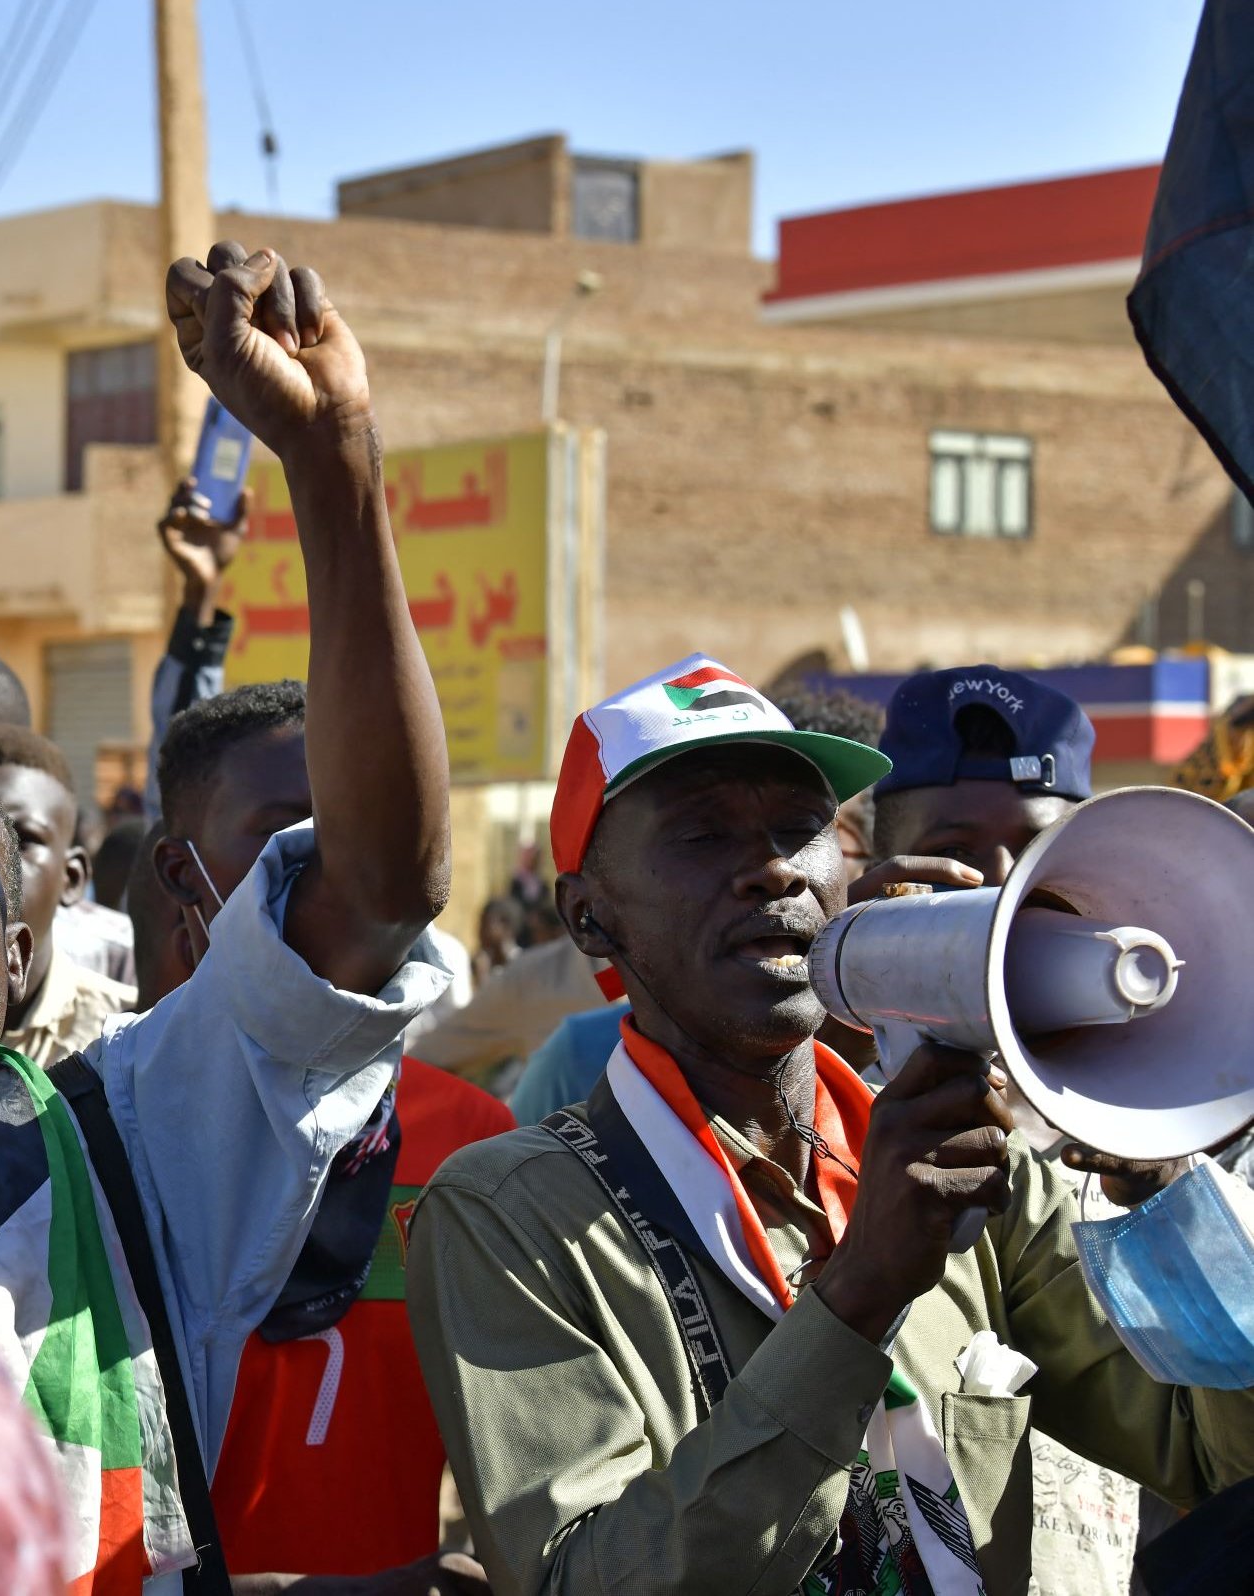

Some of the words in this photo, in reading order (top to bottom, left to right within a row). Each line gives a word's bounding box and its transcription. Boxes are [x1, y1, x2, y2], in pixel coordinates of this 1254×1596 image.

[672, 712, 721, 727] جديد
[556, 1119, 608, 1166] FILA
[672, 1275, 720, 1366] FILA
[298, 1326, 344, 1446] 7
